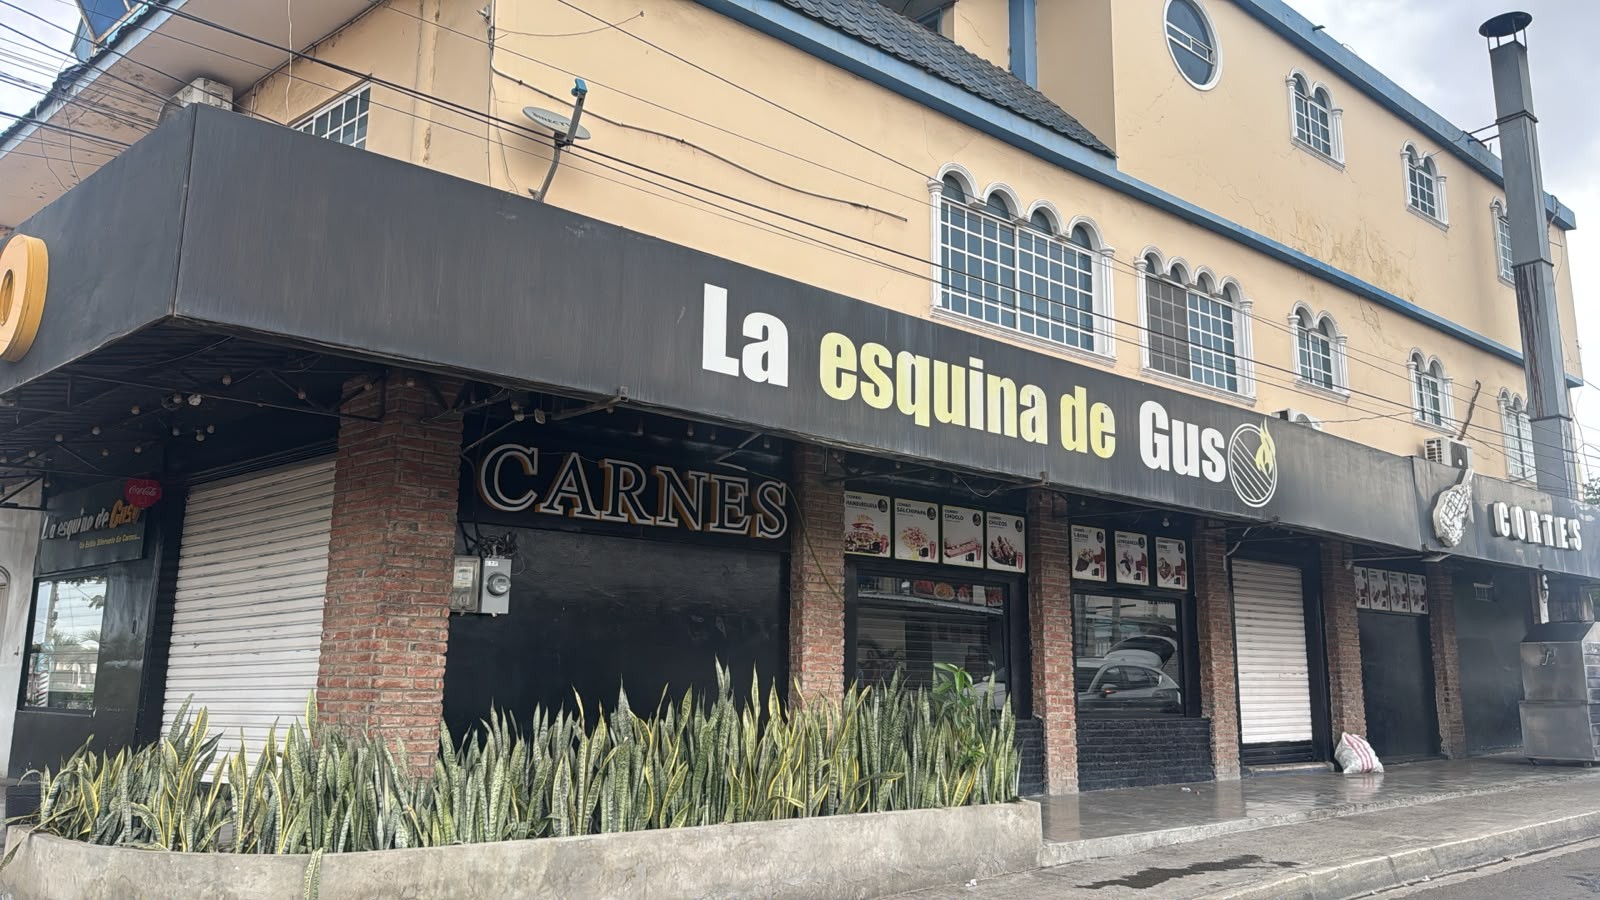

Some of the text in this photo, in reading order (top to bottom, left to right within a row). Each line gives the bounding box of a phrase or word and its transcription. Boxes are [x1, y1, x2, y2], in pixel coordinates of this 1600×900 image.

[702, 283, 789, 388] La
[819, 331, 1048, 445] esquina
[1060, 385, 1116, 459] de
[41, 515, 57, 540] La
[57, 507, 94, 540] esquina
[95, 508, 109, 530] de
[479, 443, 788, 539] CARNES
[1490, 502, 1583, 551] CORTES
